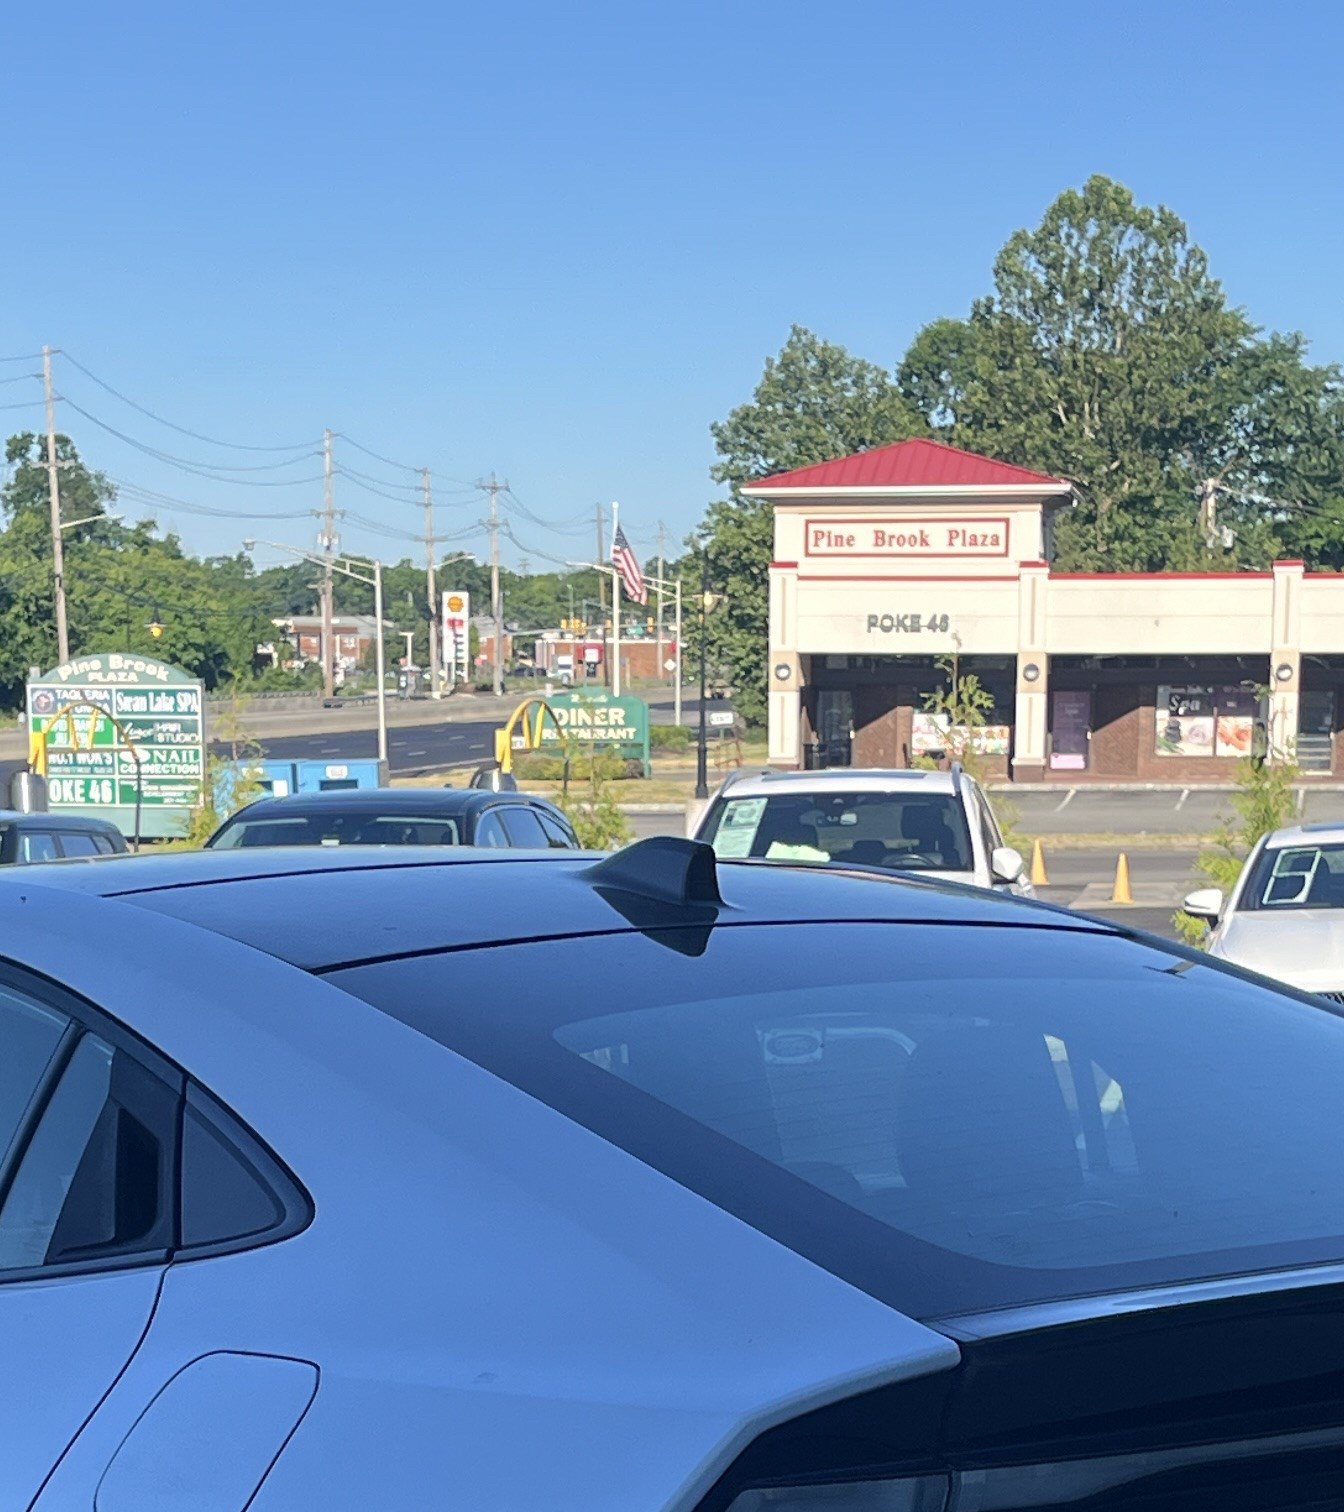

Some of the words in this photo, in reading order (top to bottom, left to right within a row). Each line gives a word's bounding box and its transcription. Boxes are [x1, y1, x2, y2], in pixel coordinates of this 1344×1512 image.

[813, 530, 856, 547] Pine
[873, 529, 931, 548] Brook
[947, 529, 1001, 547] Plaza
[867, 613, 922, 634] POKE
[57, 659, 102, 682] Pine
[108, 653, 170, 682] Brook
[87, 671, 140, 683] PLAZA
[55, 689, 111, 701] TAQERIA
[116, 691, 147, 712] Swan
[148, 691, 175, 712] Lake
[176, 691, 200, 712] SPA
[550, 707, 626, 727] DINER
[156, 732, 199, 744] STUDIO
[152, 750, 201, 764] NAIL
[49, 778, 86, 803] OKE
[88, 778, 113, 803] 46
